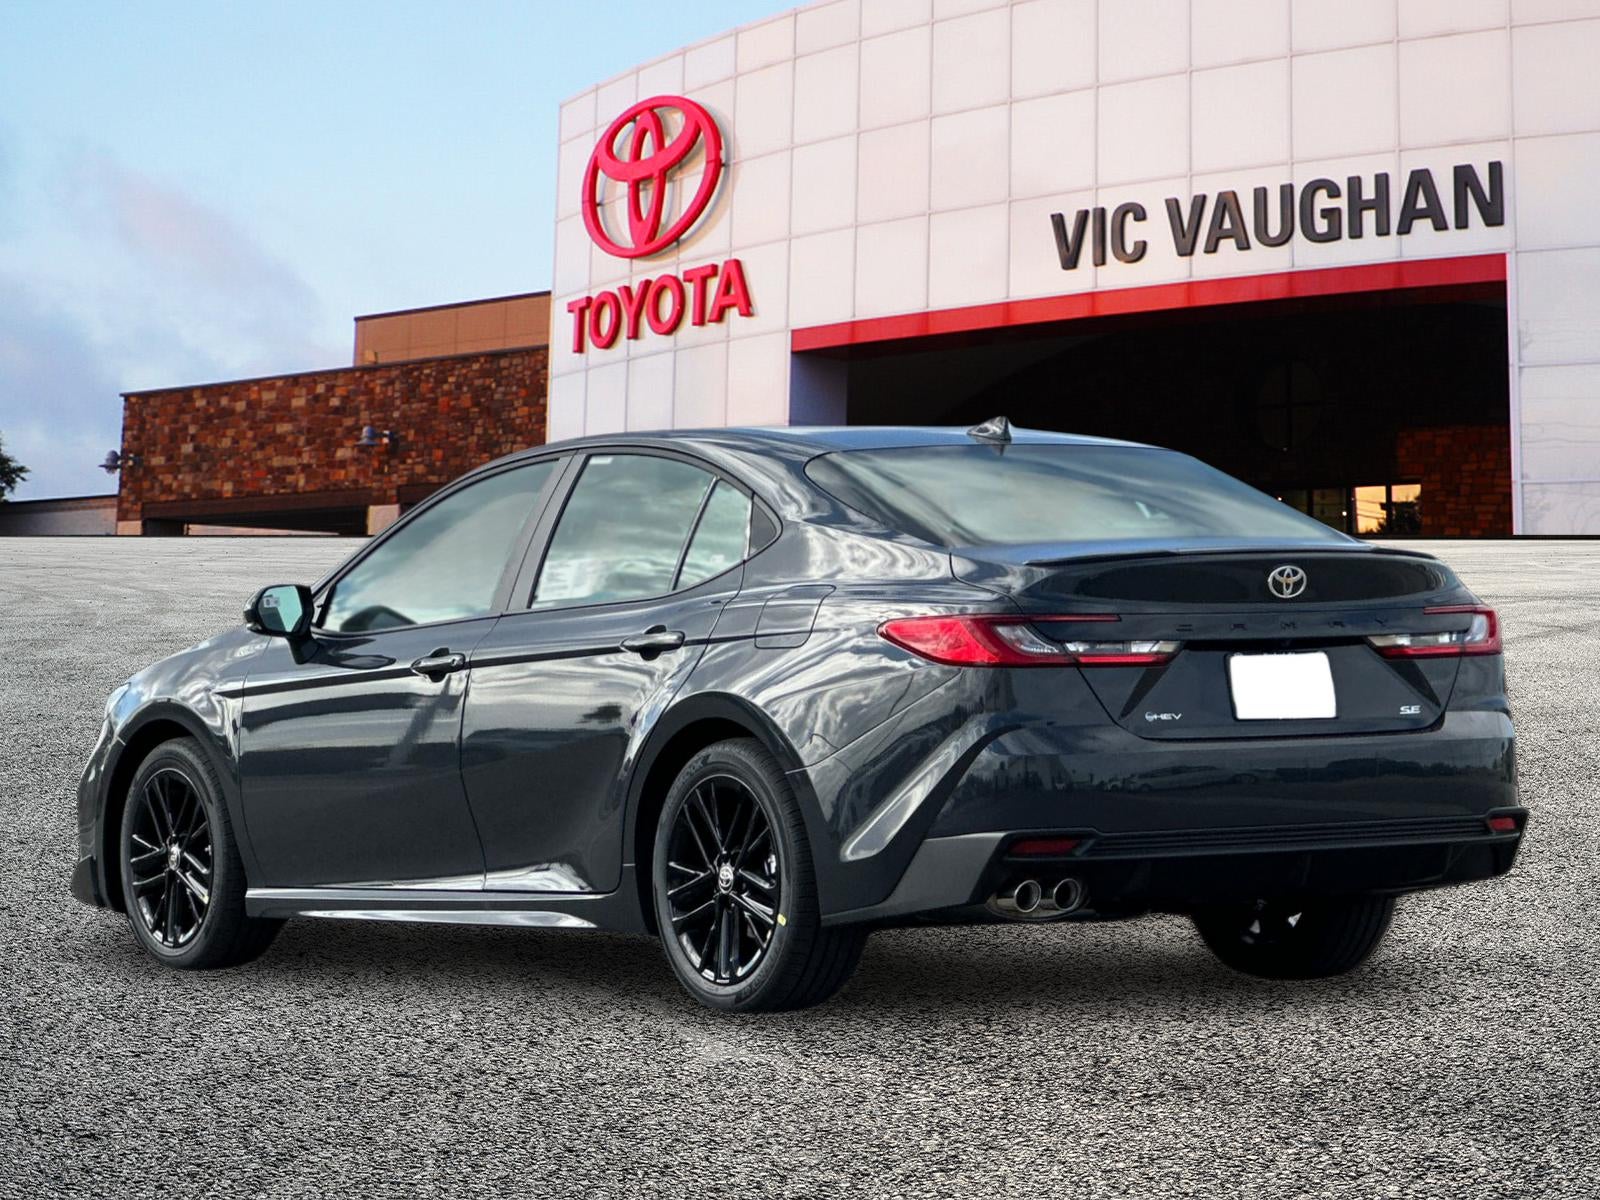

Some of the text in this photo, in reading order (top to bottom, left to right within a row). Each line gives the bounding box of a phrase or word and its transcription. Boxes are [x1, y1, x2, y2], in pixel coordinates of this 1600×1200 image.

[1050, 160, 1505, 270] VIC VAUGHAN
[567, 258, 754, 353] TOYOTA
[1399, 705, 1421, 715] SE
